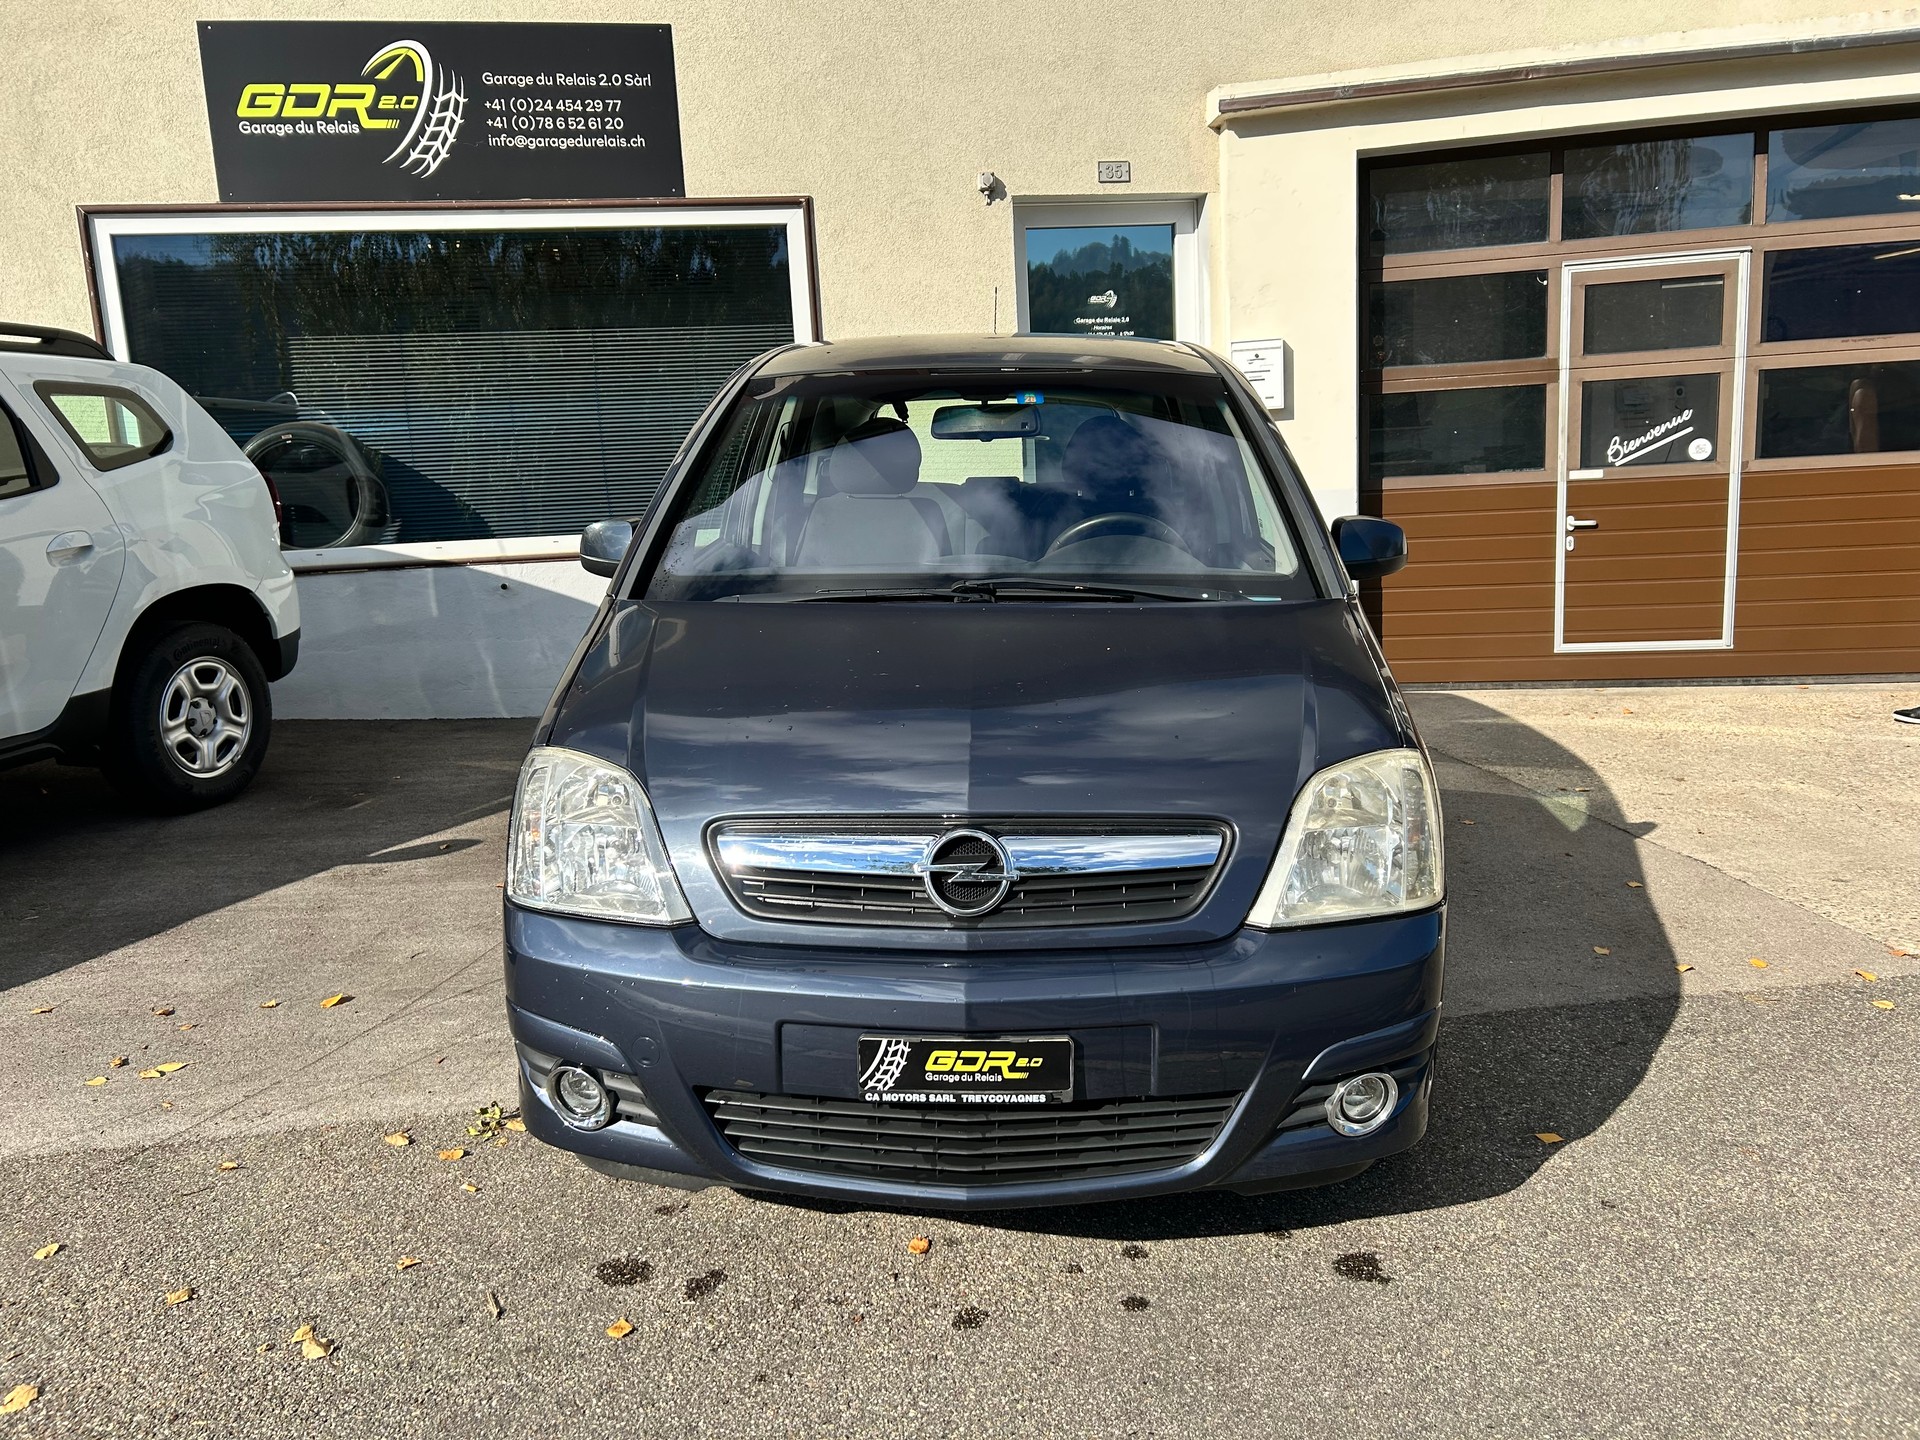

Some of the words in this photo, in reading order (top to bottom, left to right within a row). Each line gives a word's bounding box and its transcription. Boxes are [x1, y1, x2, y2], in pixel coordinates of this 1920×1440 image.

[482, 72, 533, 87] Garage
[536, 73, 552, 85] du
[556, 73, 596, 86] Relais
[599, 74, 621, 86] 2.0
[625, 74, 651, 86] Sàrl
[237, 84, 388, 128] GDR
[378, 96, 418, 109] 2.0
[485, 99, 505, 111] +41
[510, 98, 553, 113] (0)24
[556, 100, 583, 111] 454
[585, 100, 603, 112] 29
[606, 100, 621, 112] 77
[239, 121, 293, 136] Garage
[296, 121, 313, 133] du
[317, 121, 360, 134] Relais
[486, 117, 507, 129] +41
[588, 117, 602, 129] 61
[604, 118, 623, 129] 20
[489, 135, 645, 149] info@garagedurelais.ch
[1105, 164, 1123, 179] 35
[1607, 408, 1693, 463] Bienvenue
[173, 637, 220, 661] Continental
[925, 1050, 1023, 1079] GDR
[1016, 1058, 1043, 1067] 2.0
[925, 1072, 959, 1082] Garage
[962, 1072, 972, 1081] du
[975, 1073, 1002, 1082] Relais
[865, 1093, 879, 1102] CA
[883, 1093, 926, 1102] MOTORS
[929, 1094, 956, 1102] SARL
[961, 1094, 1046, 1102] TREYCOVAGNES
